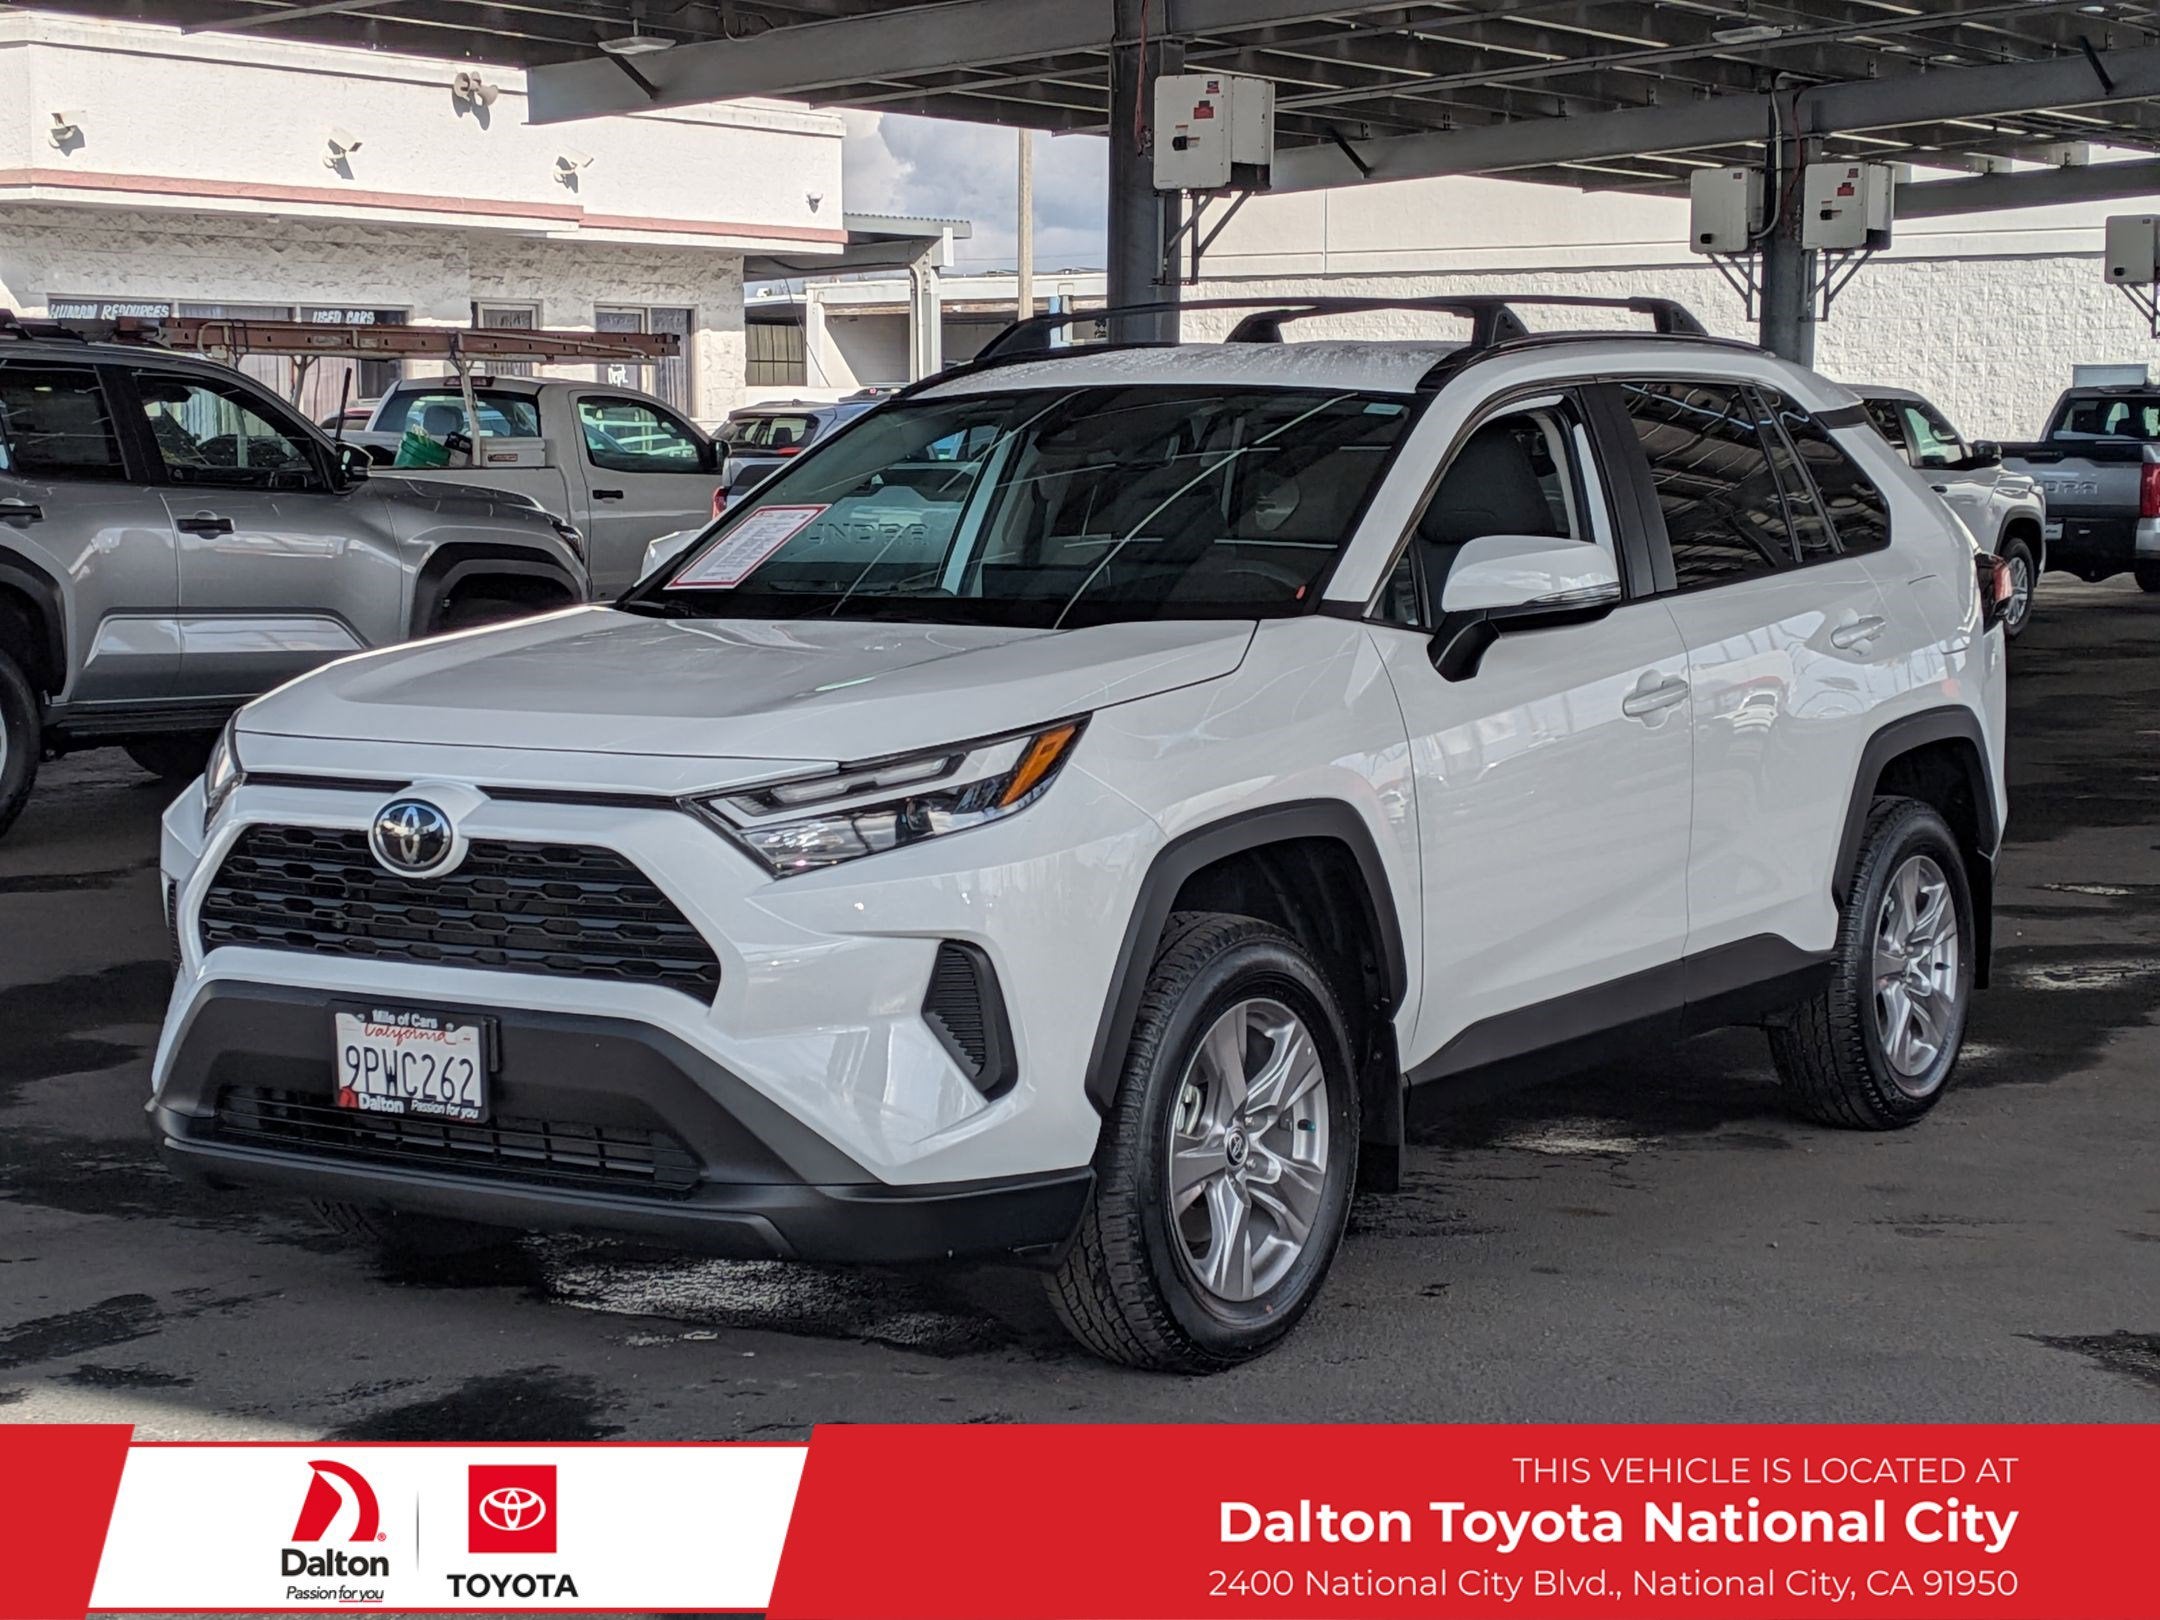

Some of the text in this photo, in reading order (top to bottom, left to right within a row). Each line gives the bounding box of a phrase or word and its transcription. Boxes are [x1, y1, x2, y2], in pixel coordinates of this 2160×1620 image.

[49, 303, 170, 320] HUMAN RESOURCES
[312, 309, 375, 325] USED CARS
[372, 1009, 438, 1030] Mile of Cars
[364, 1022, 457, 1047] California
[345, 1044, 475, 1107] 9PWC262
[358, 1092, 405, 1114] Dalton
[410, 1099, 480, 1120] Passion for you
